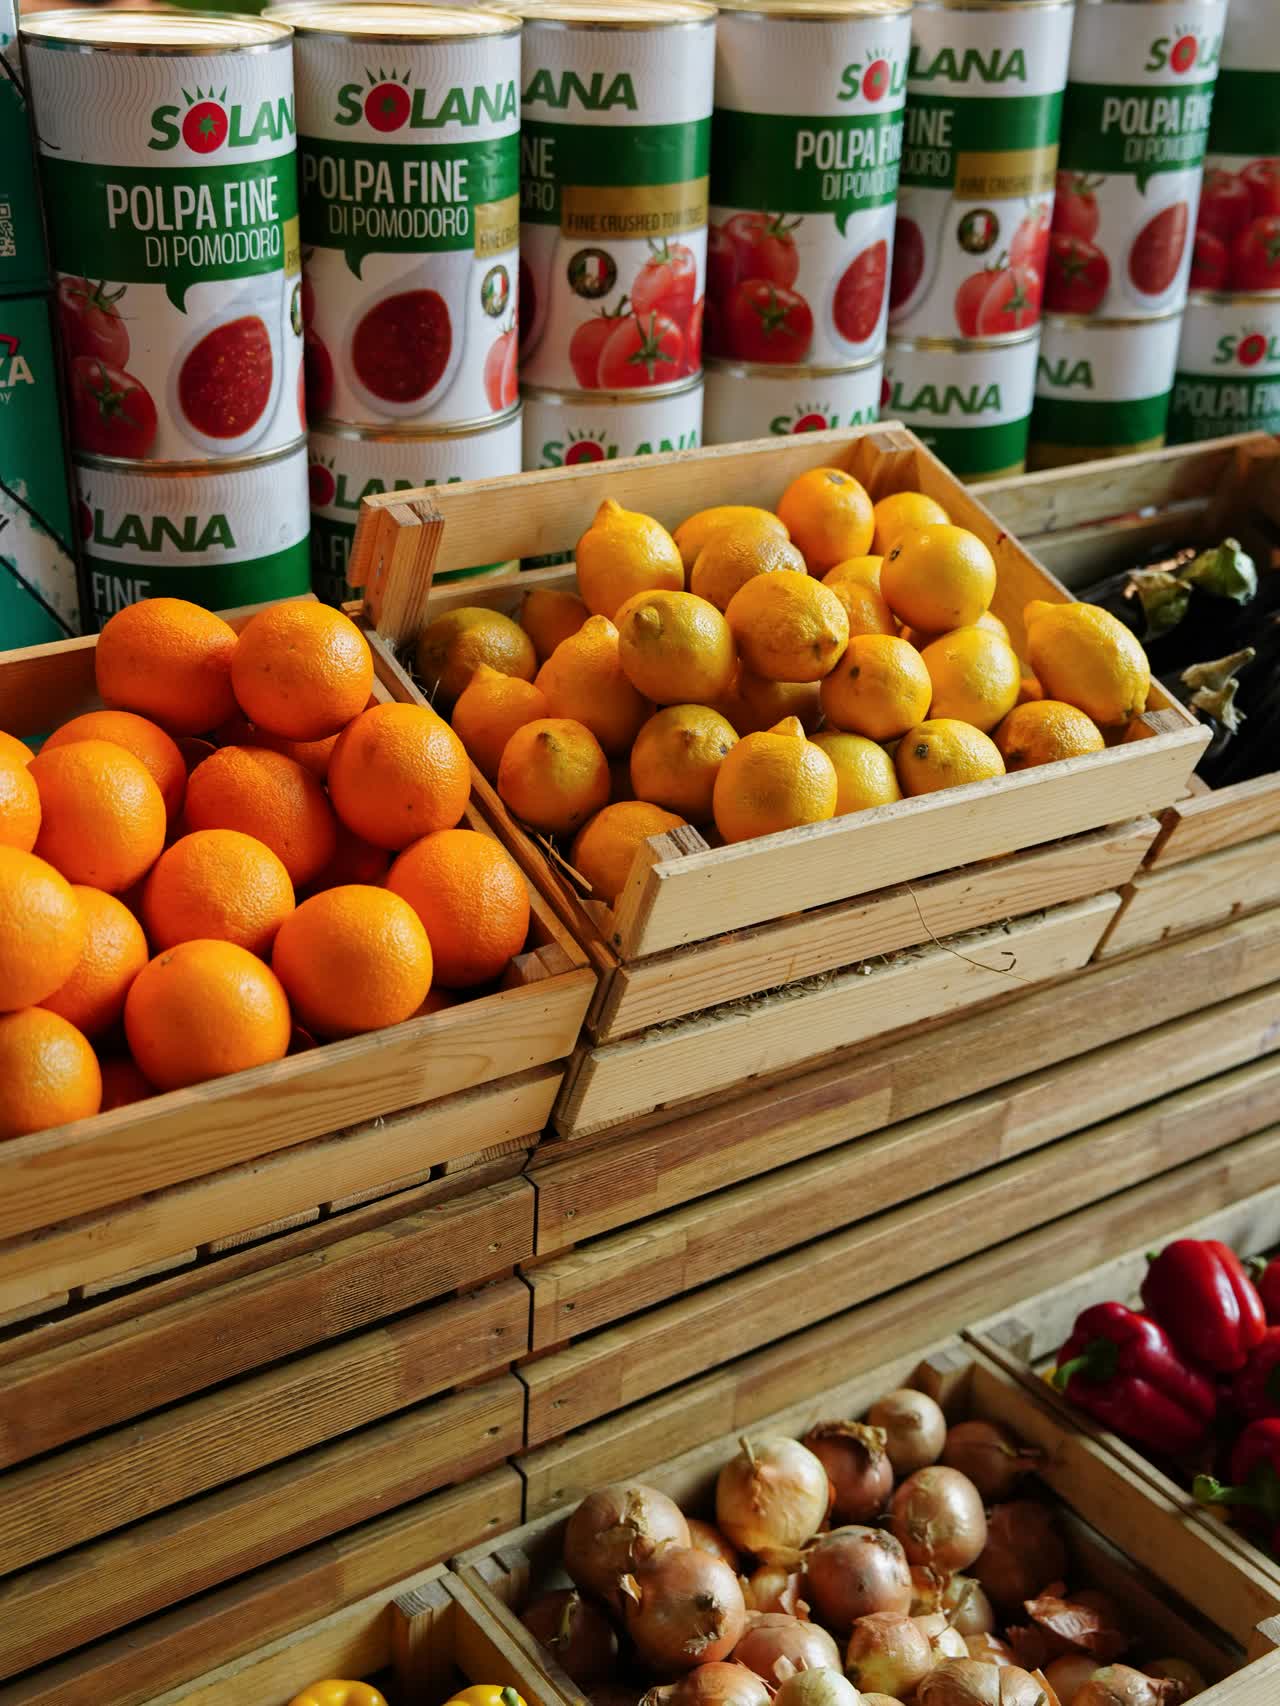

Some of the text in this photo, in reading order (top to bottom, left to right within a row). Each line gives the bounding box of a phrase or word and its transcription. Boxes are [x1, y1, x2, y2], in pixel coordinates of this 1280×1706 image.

[335, 80, 517, 132] SOLANA
[522, 69, 638, 110] ANA
[906, 107, 955, 148] INE
[1102, 97, 1180, 135] POLPA
[795, 128, 876, 170] POLPA
[303, 154, 469, 204] POLPA FINE
[821, 172, 841, 200] DI
[106, 176, 279, 231] POLPA FINE
[329, 204, 348, 236] DI
[353, 206, 469, 238] POMODORO
[600, 213, 659, 233] CRUSHED
[145, 237, 168, 268] DI
[173, 224, 280, 266] POMODORO
